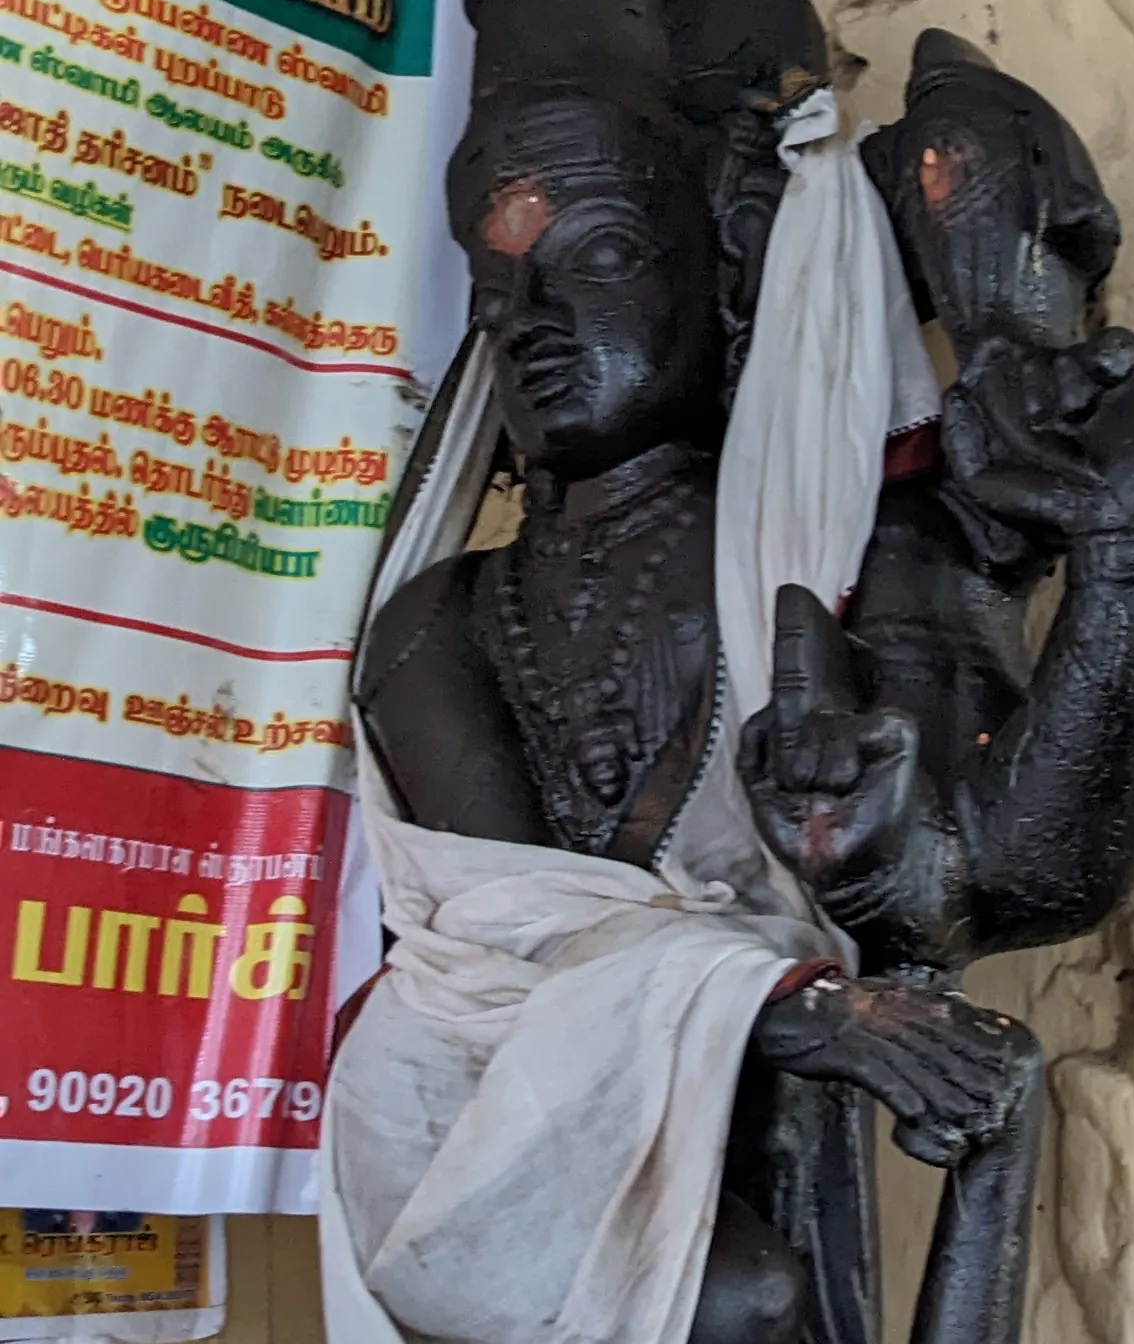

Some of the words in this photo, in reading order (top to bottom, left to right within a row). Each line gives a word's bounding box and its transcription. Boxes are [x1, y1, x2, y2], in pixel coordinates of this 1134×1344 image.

[154, 48, 286, 120] புறப்பாடு
[278, 41, 389, 116] ஸ்வாமி
[145, 92, 254, 151] ஆலயம்
[285, 436, 389, 486] முடிந்து
[12, 894, 316, 1000] பார்க்
[27, 1068, 173, 1119] 90920
